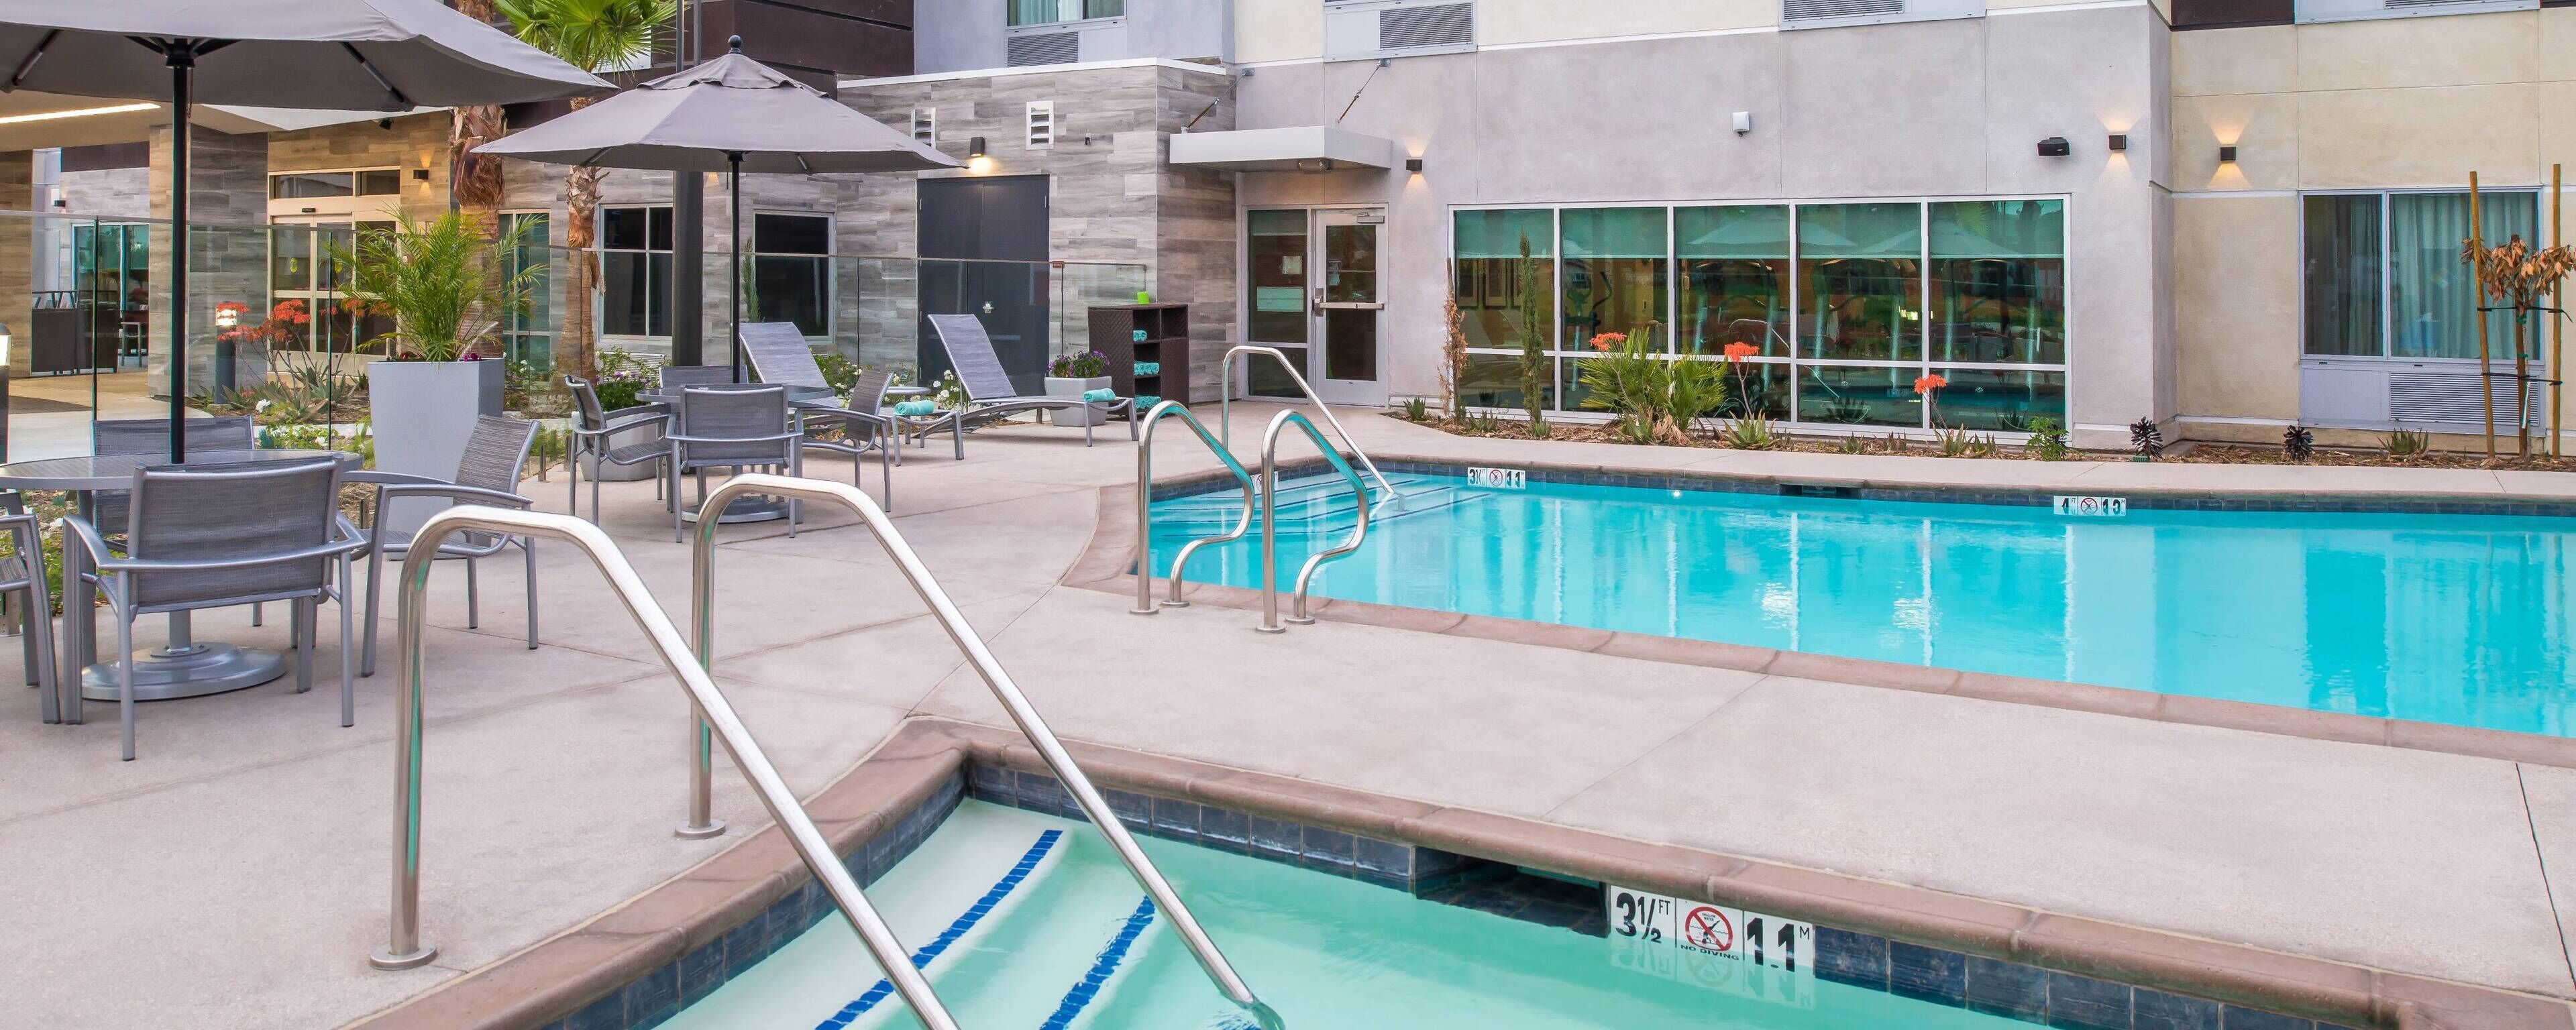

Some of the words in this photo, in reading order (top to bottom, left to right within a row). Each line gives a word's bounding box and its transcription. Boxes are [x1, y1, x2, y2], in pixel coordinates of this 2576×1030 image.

[1658, 899, 1670, 915] FT
[1747, 917, 1795, 972] 1.1
[1799, 925, 1810, 940] M
[1700, 948, 1739, 960] DIVING
